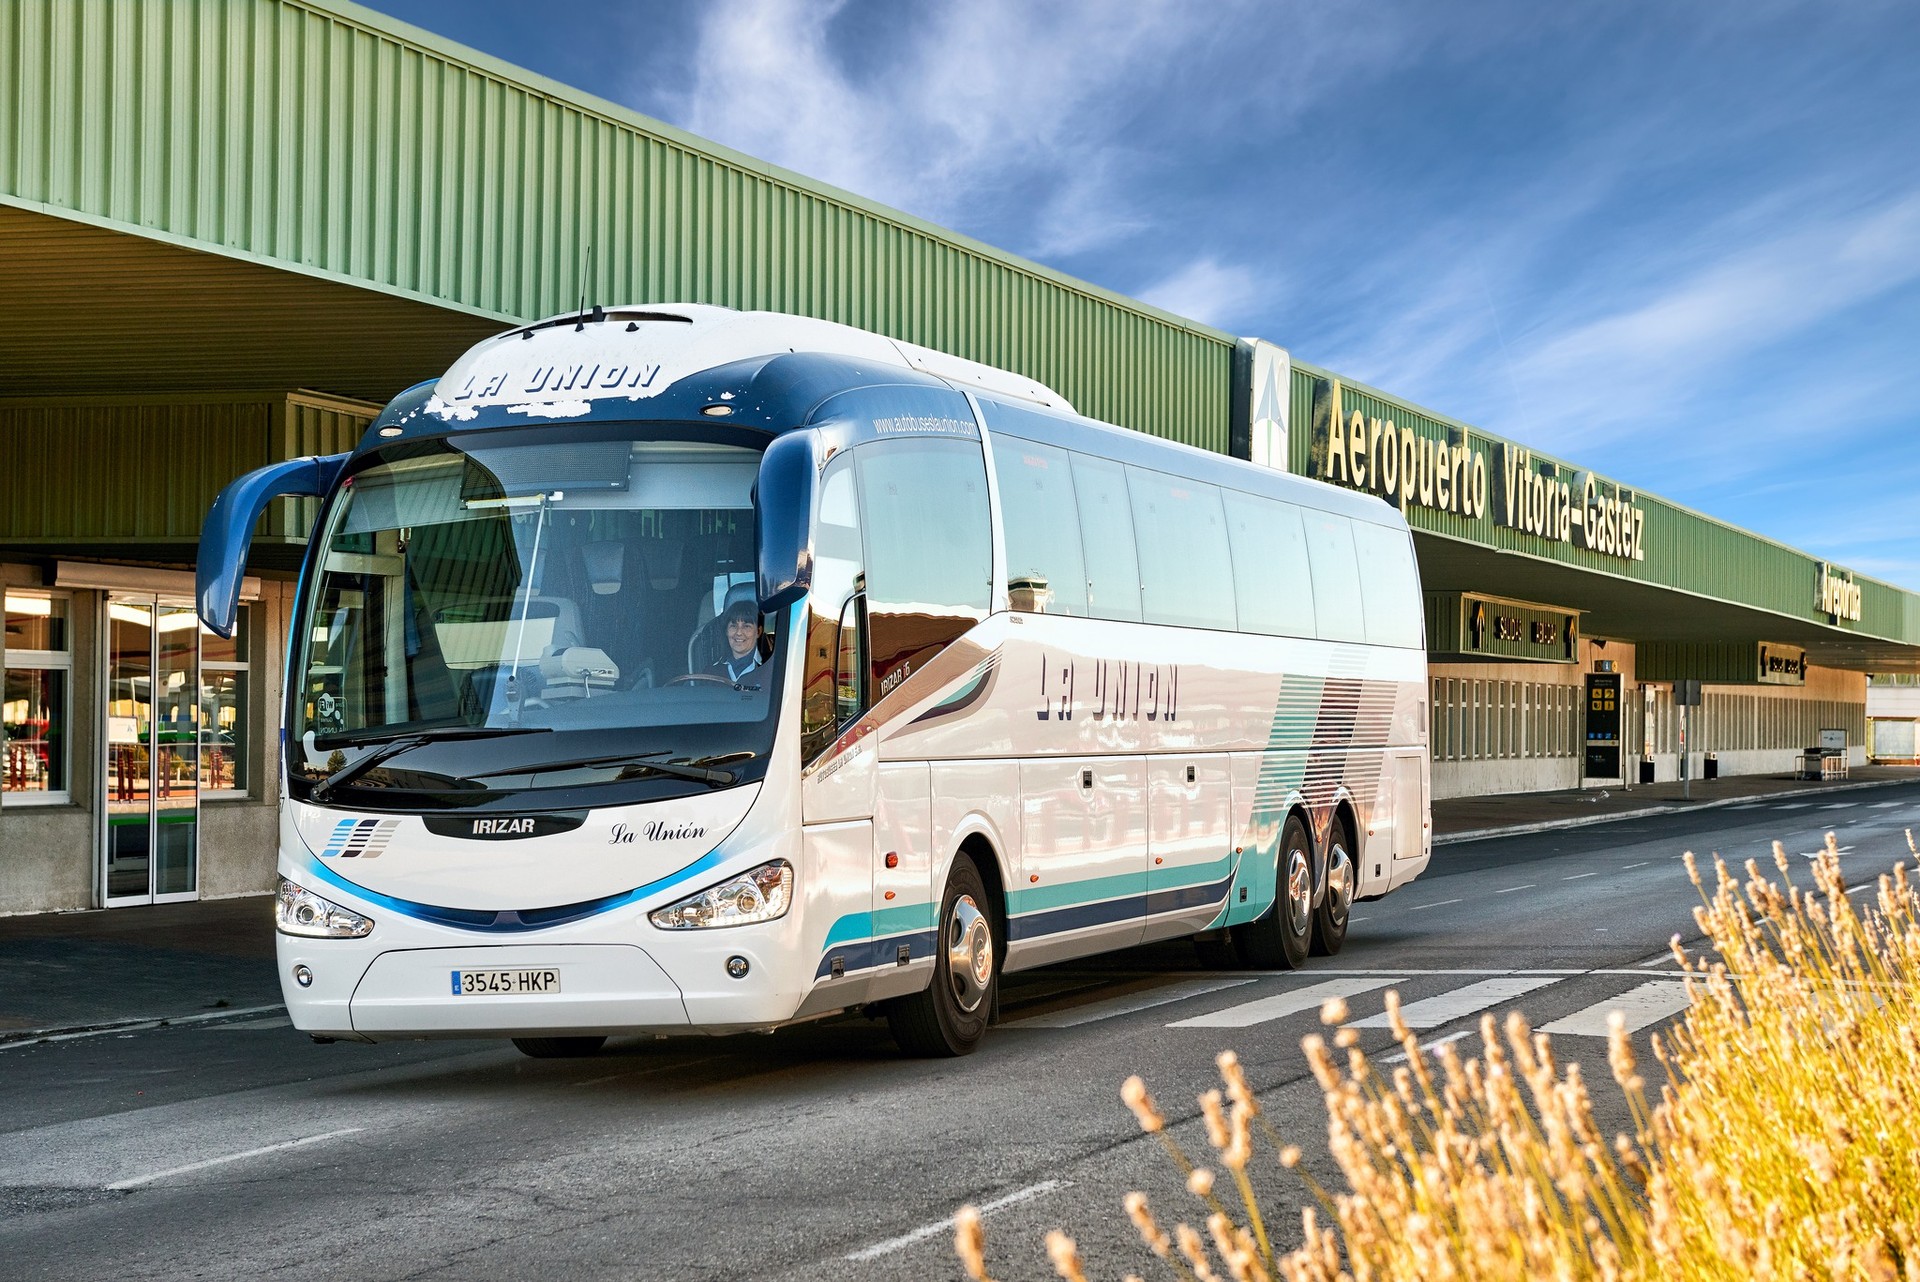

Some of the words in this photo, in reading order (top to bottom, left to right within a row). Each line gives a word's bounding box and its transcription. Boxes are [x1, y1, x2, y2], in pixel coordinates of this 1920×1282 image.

[454, 371, 508, 401] LA
[523, 363, 661, 393] UNION
[872, 412, 979, 436] www.autobuseslaunion.com
[1327, 378, 1486, 520] Aeropuerto
[1503, 442, 1645, 562] Vitoria-Gasteiz
[880, 668, 902, 696] IRIZAR
[1036, 651, 1075, 722] LA
[1092, 657, 1178, 722] UNION
[472, 818, 536, 835] IRIZAR
[608, 823, 638, 844] La
[643, 820, 710, 842] Unión
[464, 973, 512, 992] 3545
[519, 972, 555, 991] HKP
